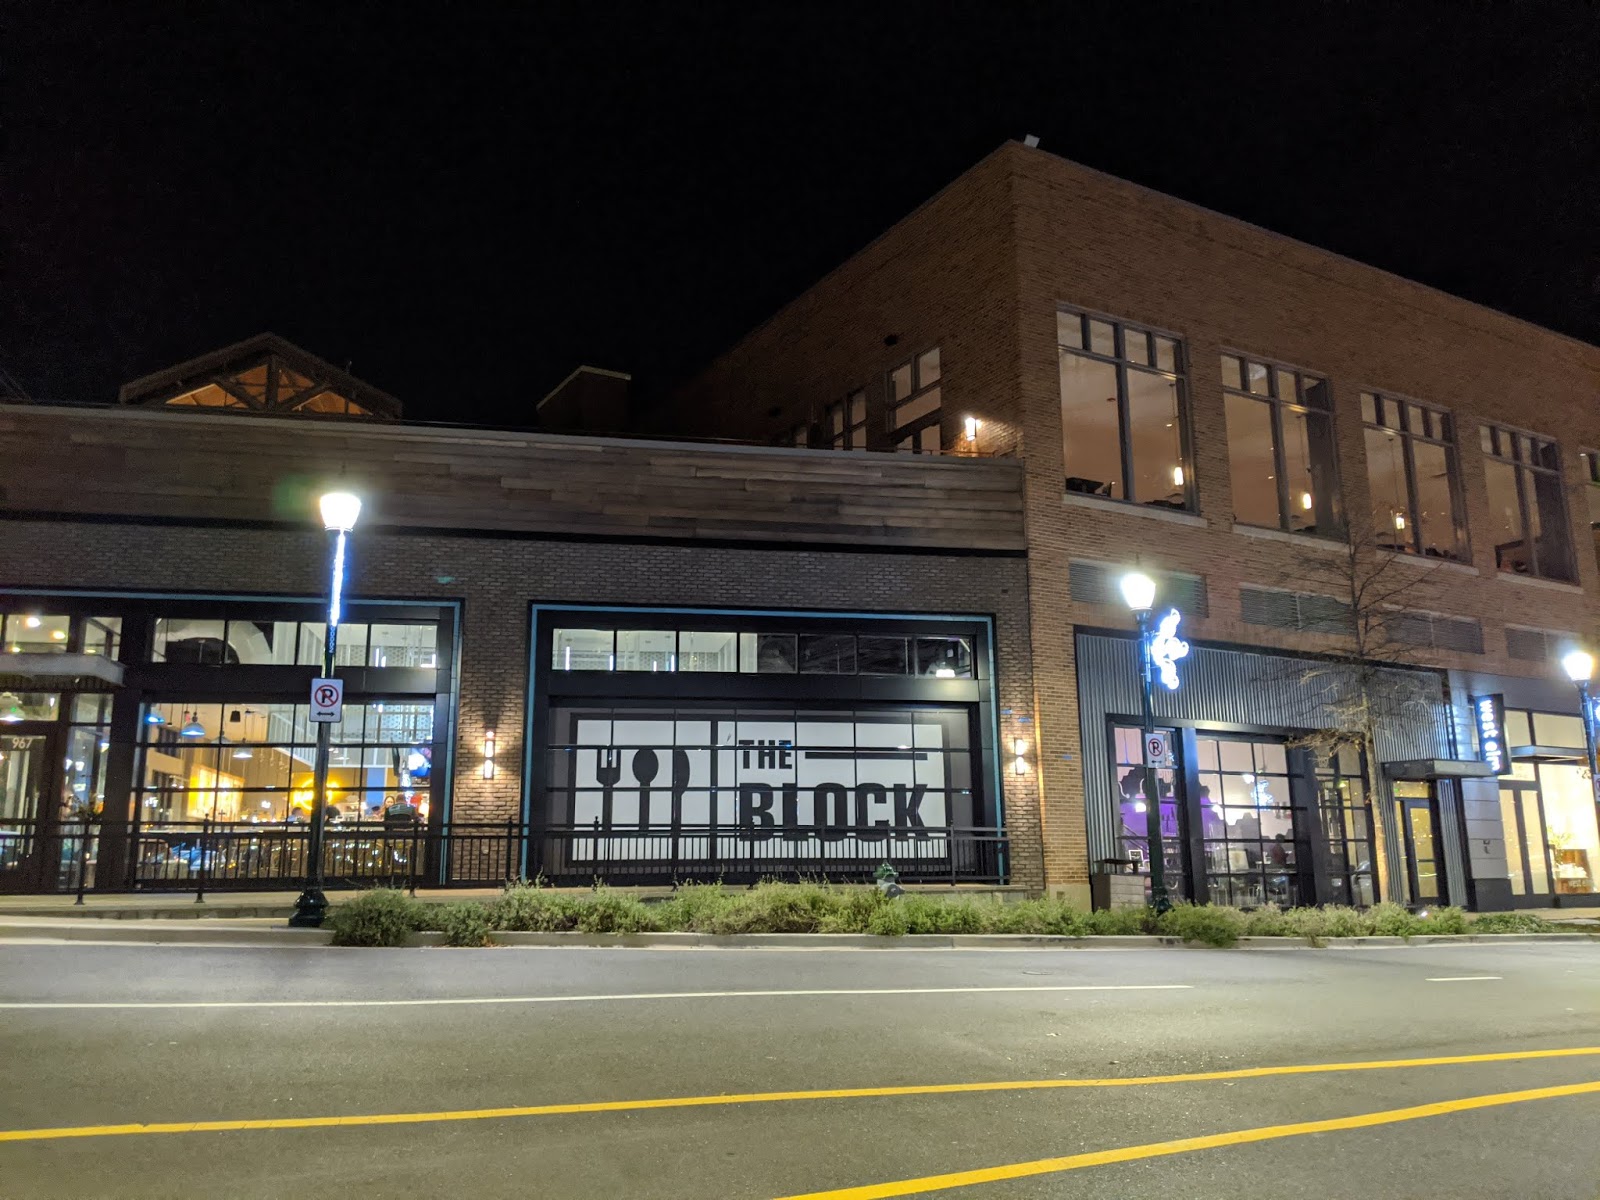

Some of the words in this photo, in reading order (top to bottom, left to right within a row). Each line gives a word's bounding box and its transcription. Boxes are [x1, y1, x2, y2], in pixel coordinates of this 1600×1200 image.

[1480, 699, 1499, 739] west
[12, 737, 33, 749] 967
[738, 739, 793, 769] THE
[1484, 741, 1502, 771] elm
[739, 782, 932, 842] BLOCK
